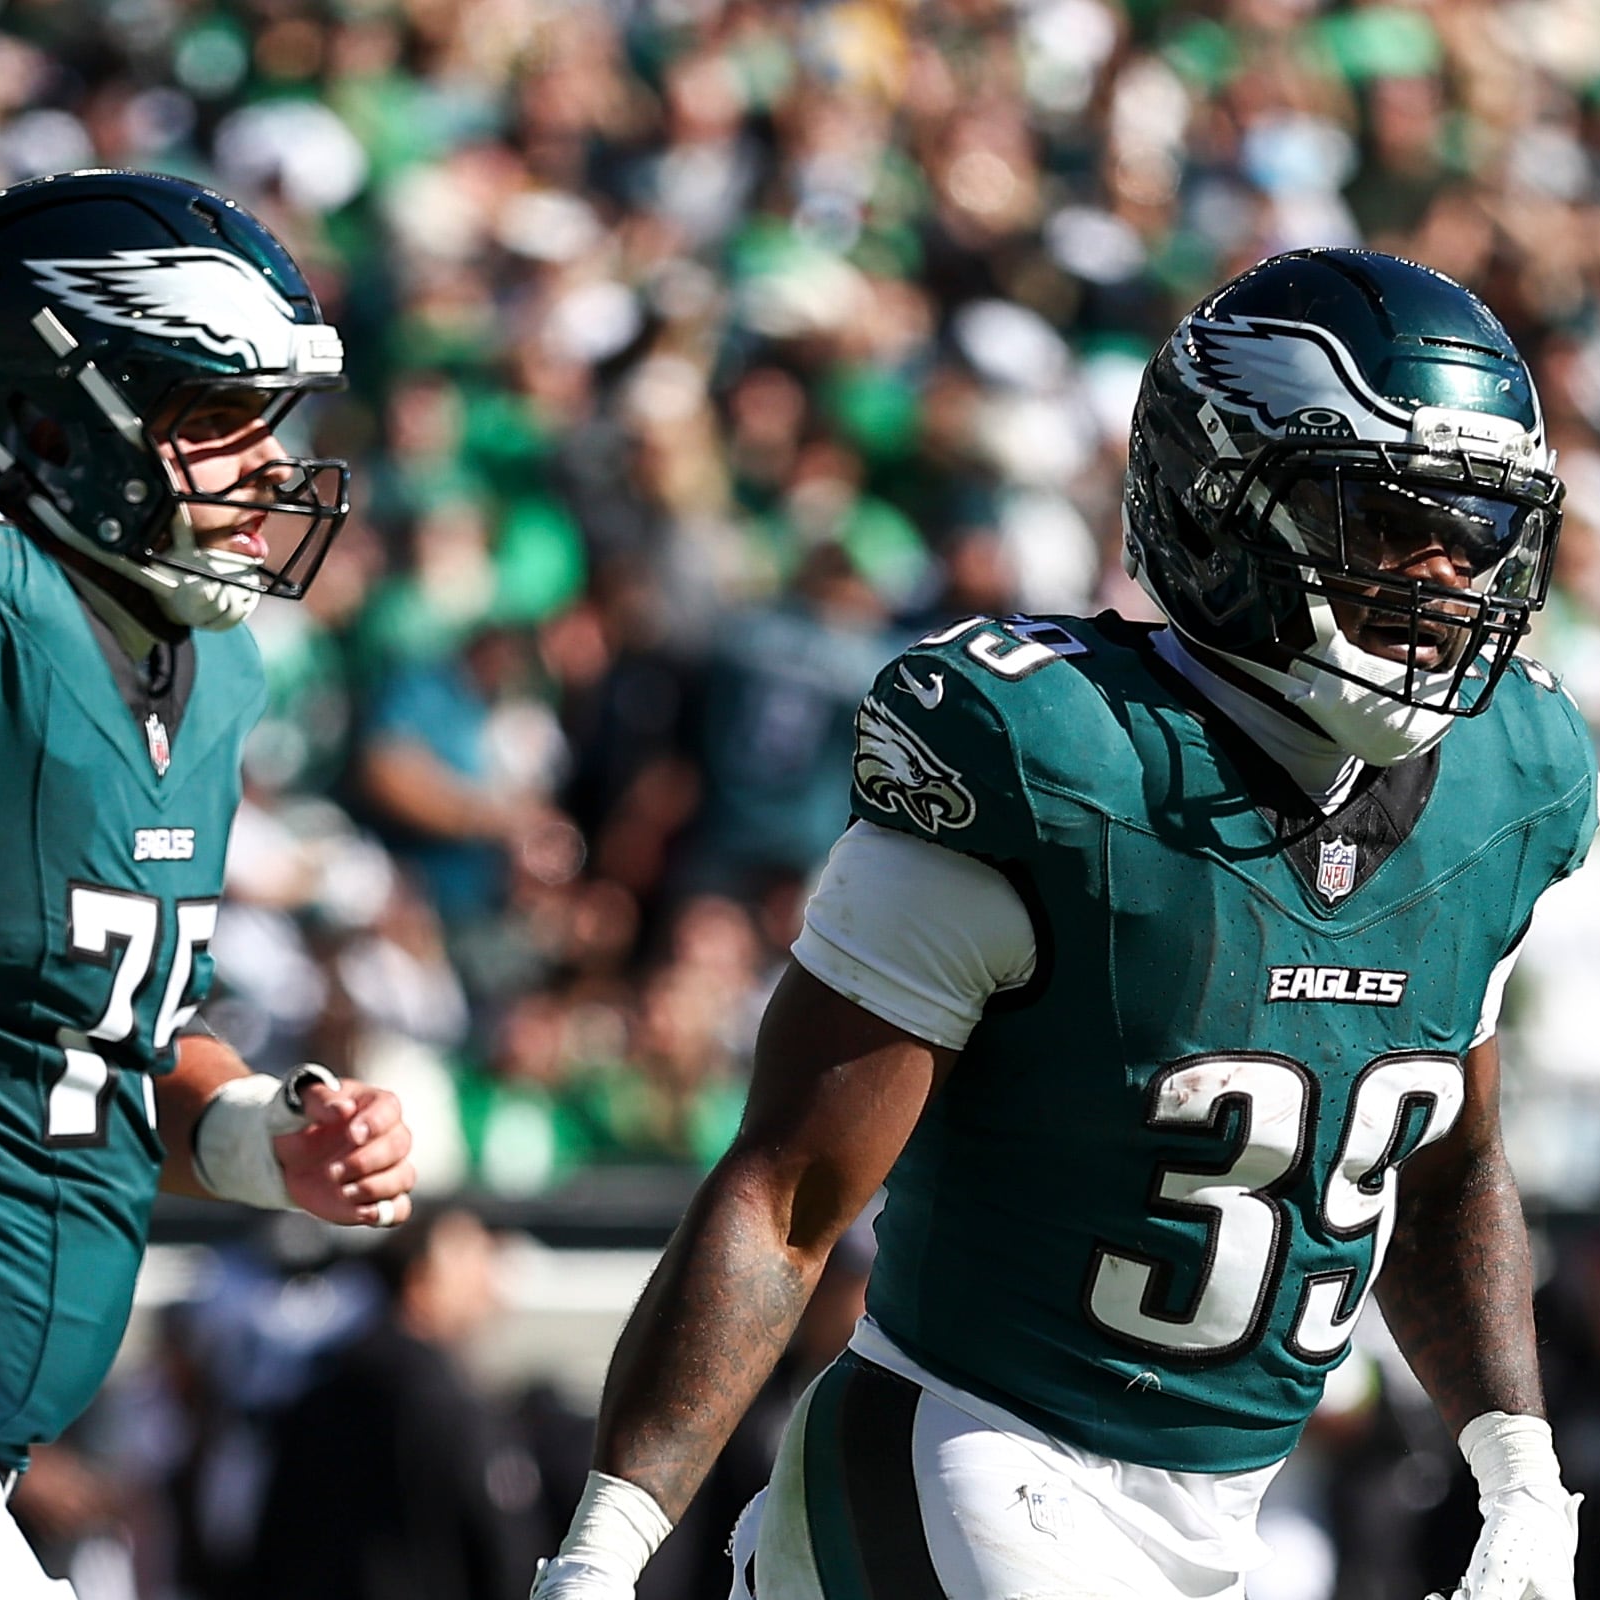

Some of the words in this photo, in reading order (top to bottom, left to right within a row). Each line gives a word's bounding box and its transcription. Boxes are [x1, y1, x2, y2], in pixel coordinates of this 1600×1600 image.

[1288, 426, 1350, 437] OAKLEY
[1322, 865, 1348, 889] NFL
[1267, 966, 1409, 1005] EAGLES
[1083, 1049, 1465, 1364] 39
